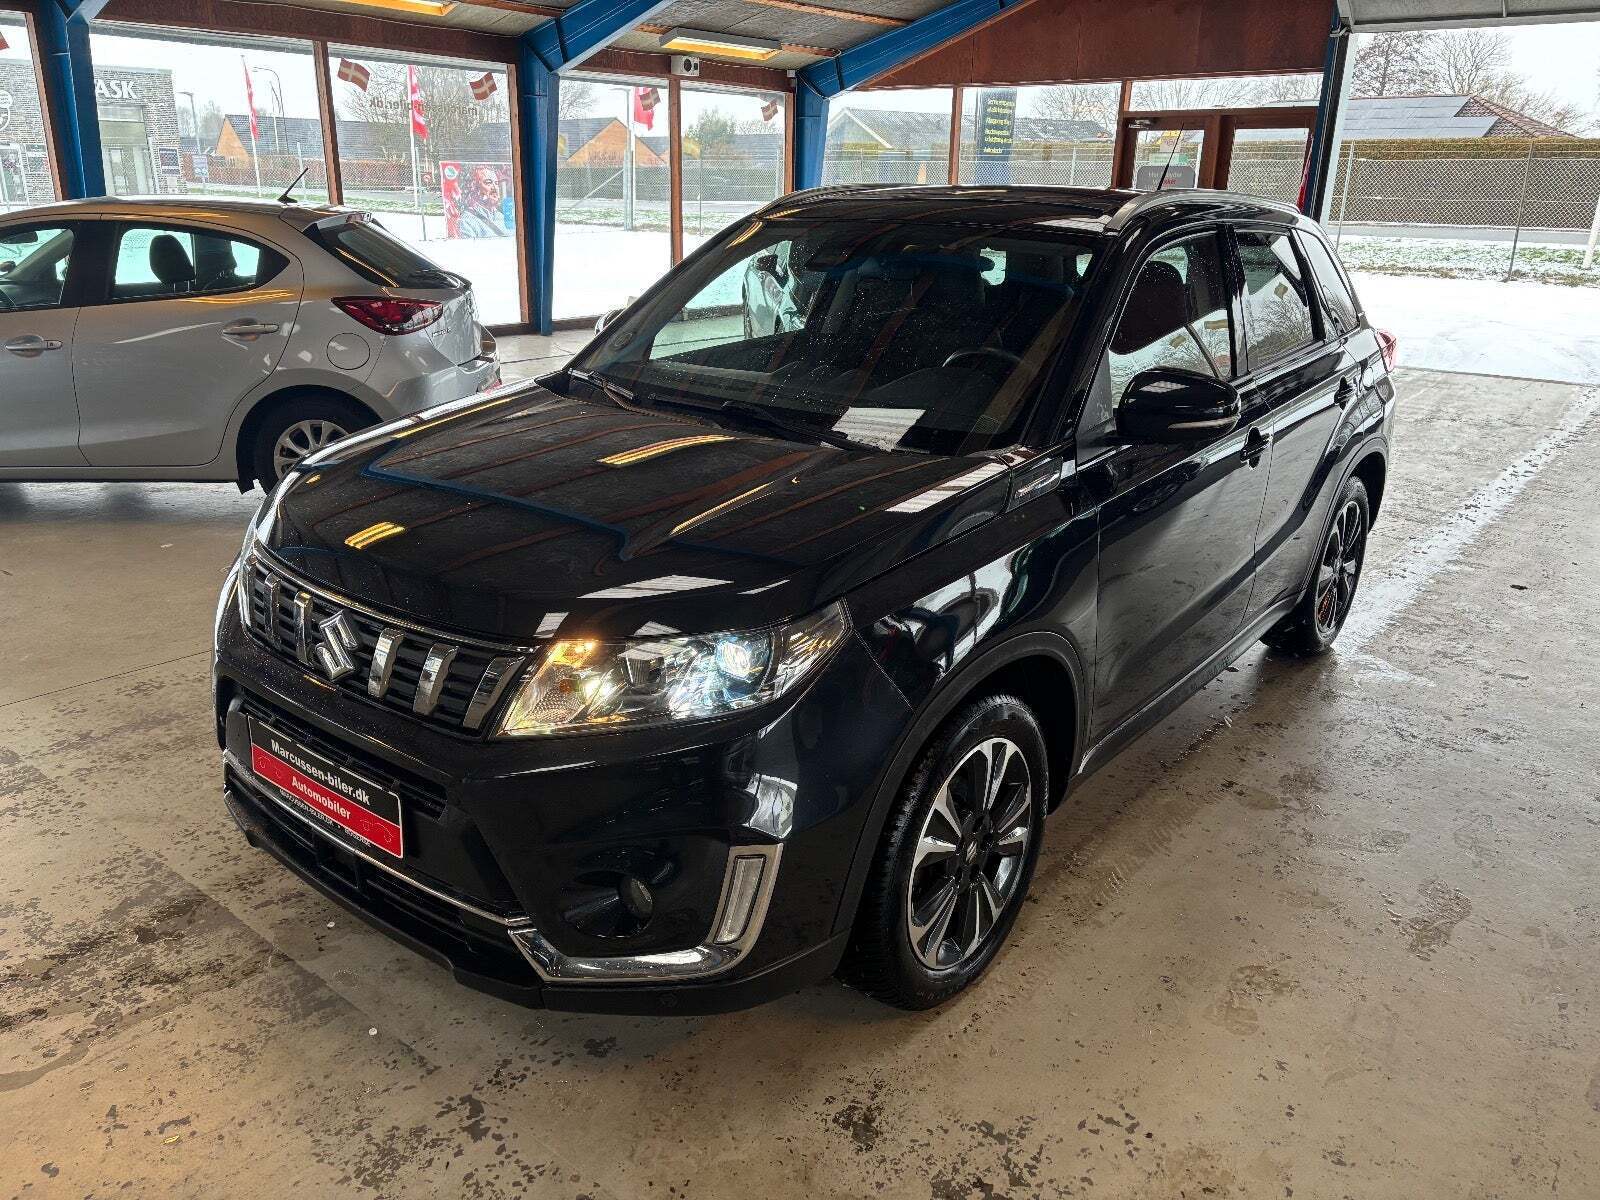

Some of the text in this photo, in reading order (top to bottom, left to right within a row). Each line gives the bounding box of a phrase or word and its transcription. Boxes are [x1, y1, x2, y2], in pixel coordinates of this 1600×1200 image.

[94, 79, 138, 99] ASK
[271, 739, 370, 806] Marcussen-biler.dk
[291, 776, 351, 820] Automobiler
